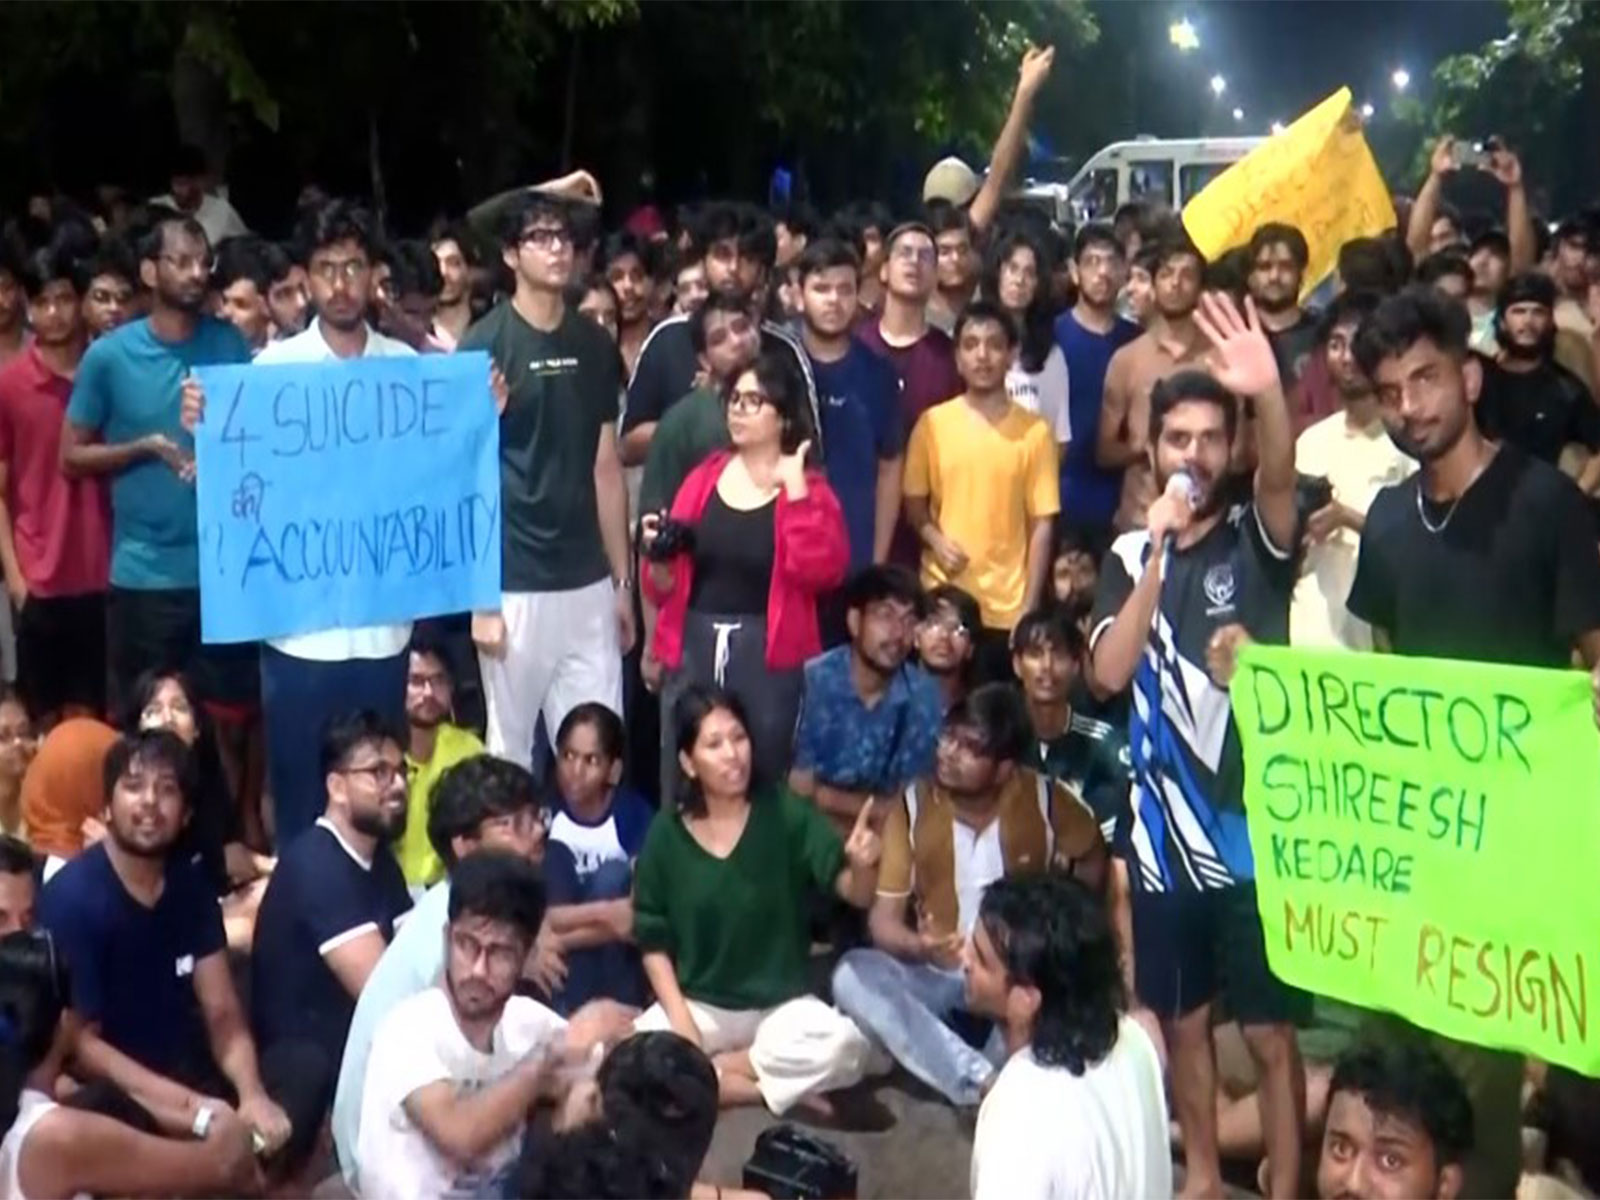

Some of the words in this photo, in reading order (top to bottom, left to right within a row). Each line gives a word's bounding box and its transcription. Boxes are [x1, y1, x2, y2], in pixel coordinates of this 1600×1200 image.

[220, 380, 262, 468] 4
[271, 378, 449, 457] SUICIDE
[241, 493, 498, 589] ACCOUNTABILITY
[1251, 663, 1532, 775] DIRECTOR
[1261, 753, 1487, 853] SHIREESH
[1271, 833, 1414, 893] KEDARE
[1284, 899, 1389, 971] MUST
[1416, 921, 1587, 1044] RESIGN
